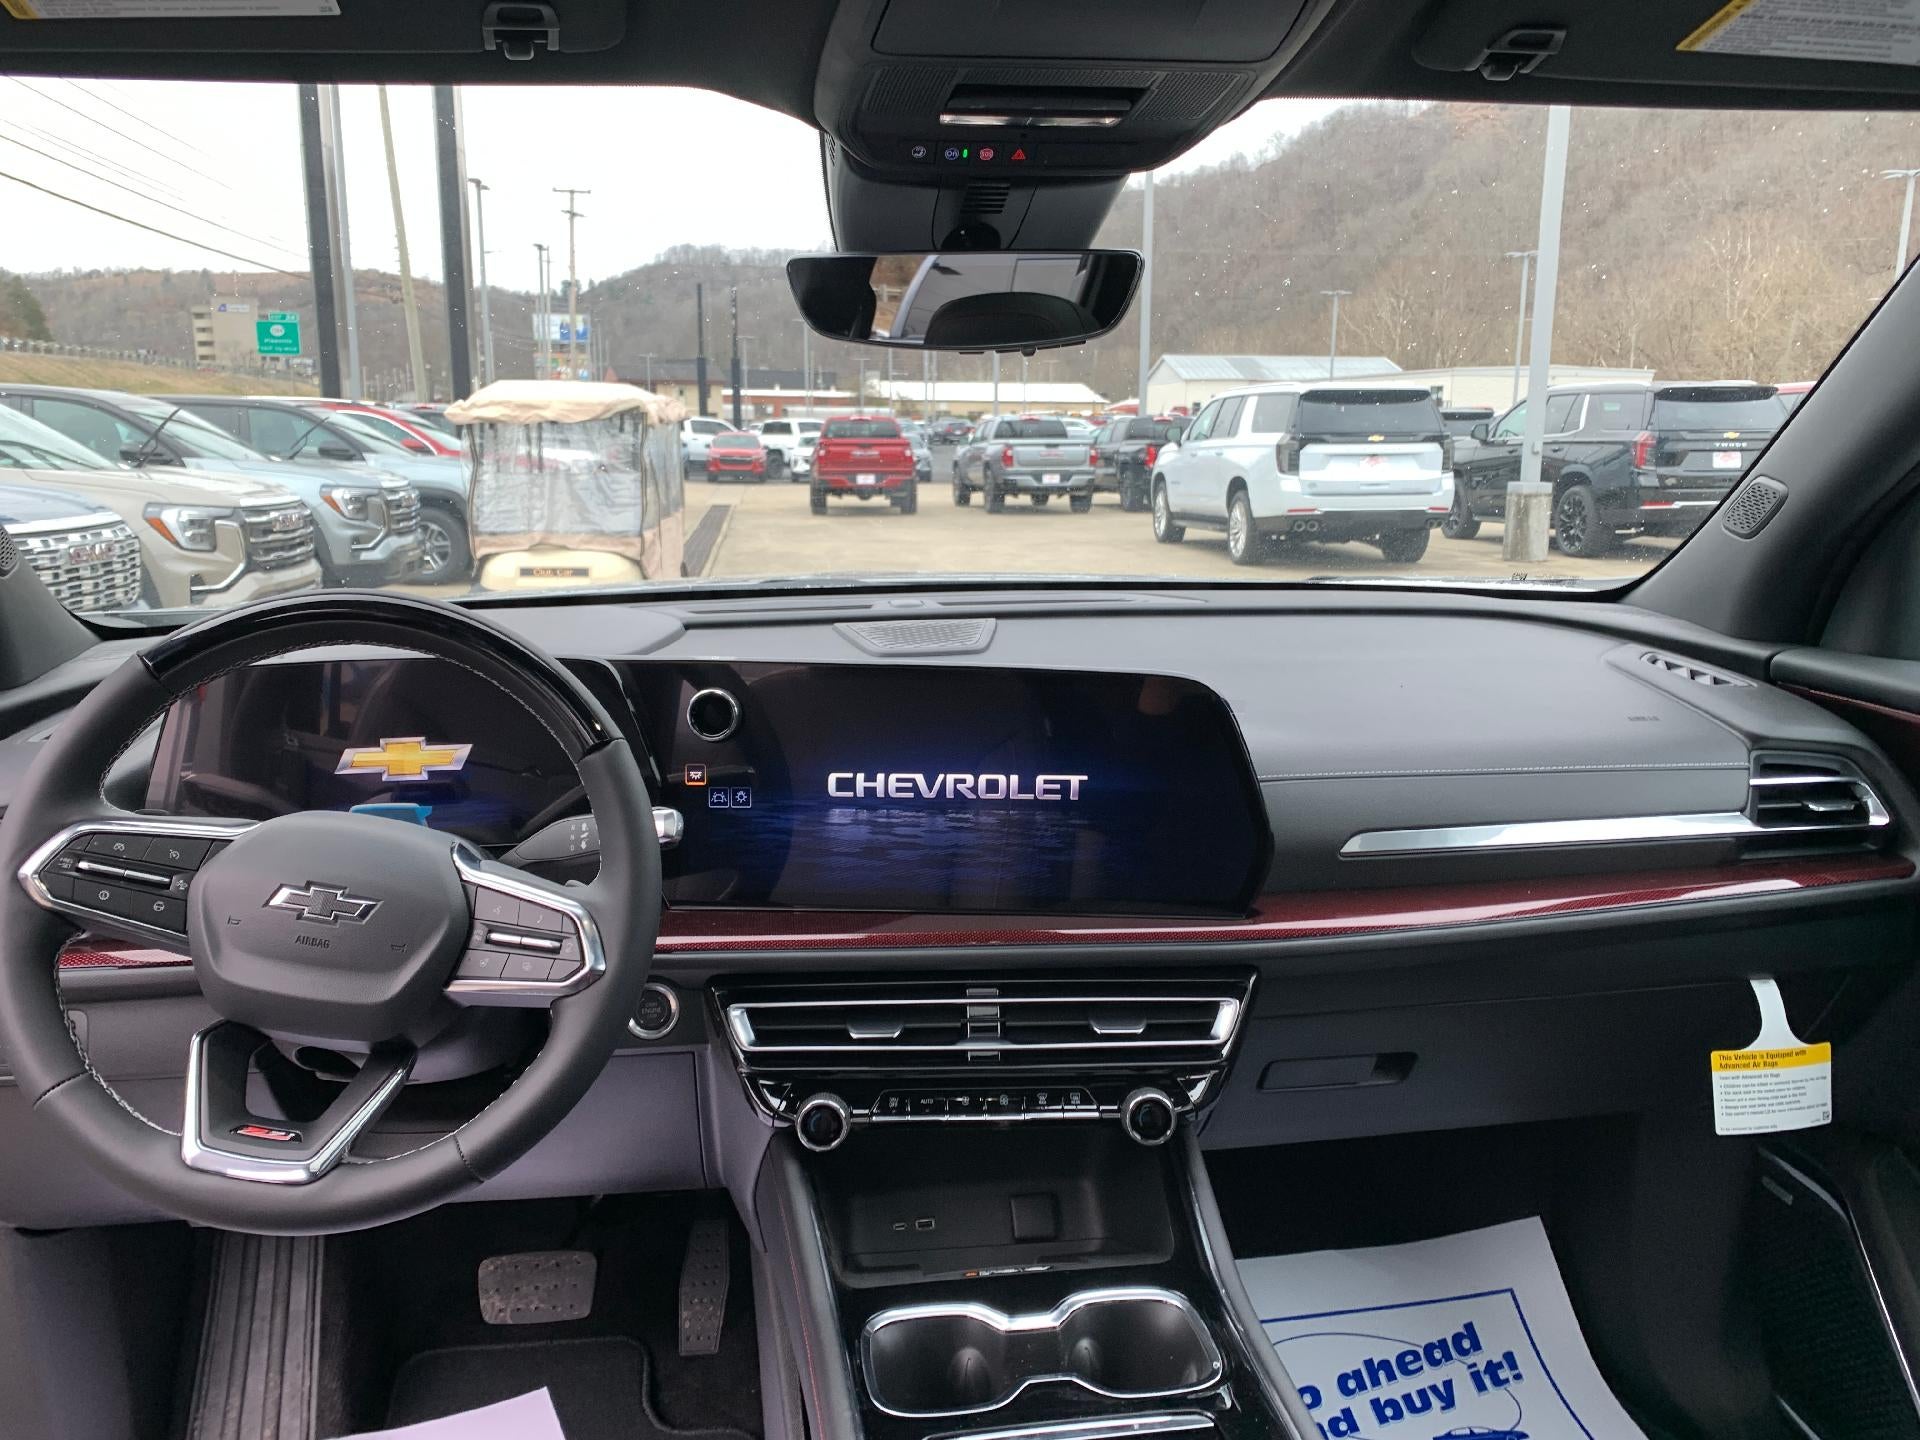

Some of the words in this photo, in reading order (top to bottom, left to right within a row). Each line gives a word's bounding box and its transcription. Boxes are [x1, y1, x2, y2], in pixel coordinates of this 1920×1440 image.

[827, 772, 1089, 801] CHEVROLET
[294, 935, 331, 949] AIRBAG
[1734, 1053, 1758, 1061] Vehicle
[1766, 1050, 1794, 1060] Equipped
[1763, 1061, 1778, 1069] Bags
[1337, 1320, 1483, 1398] ahead
[1369, 1377, 1456, 1426] buy
[1467, 1350, 1524, 1393] it!
